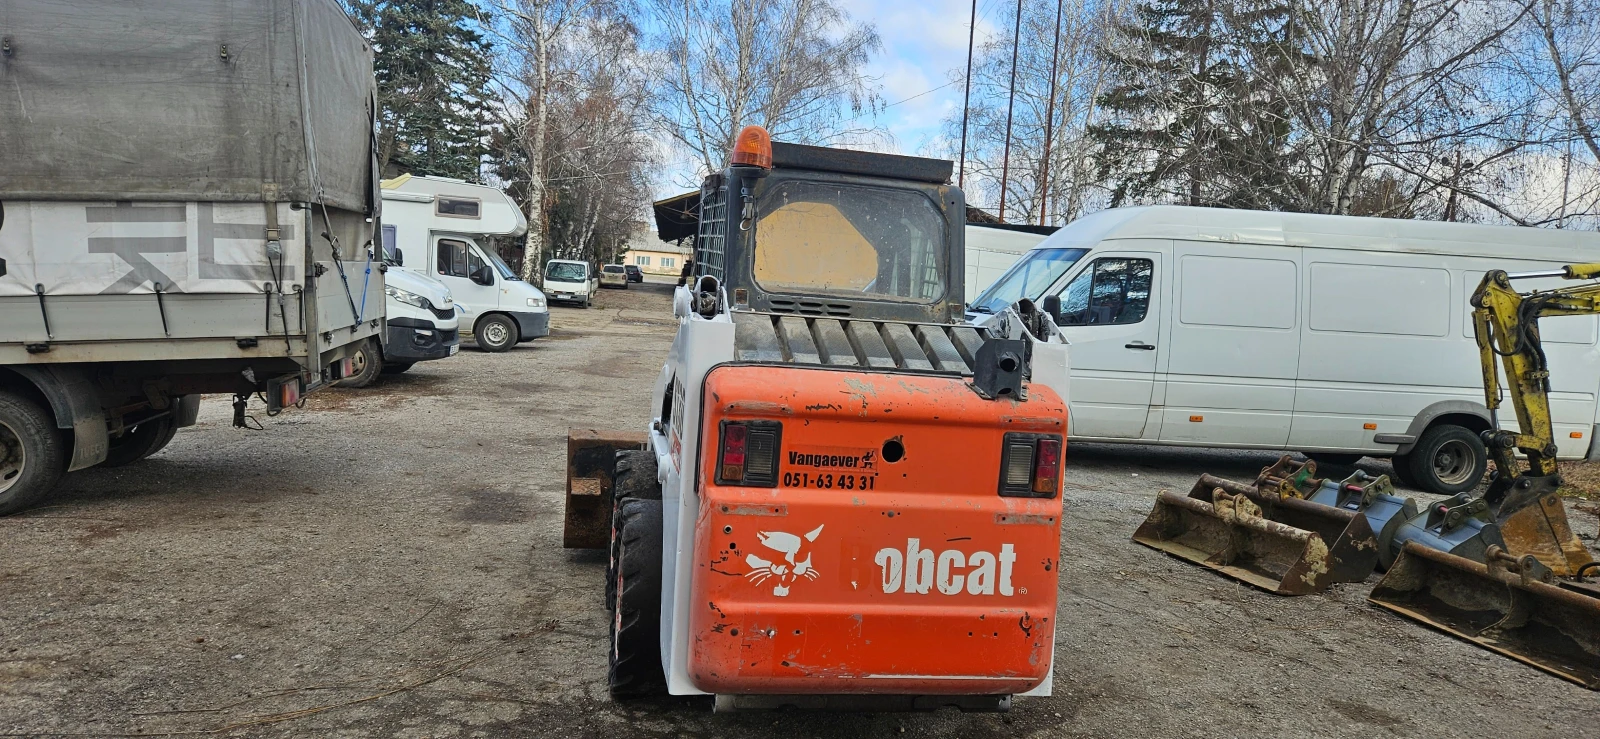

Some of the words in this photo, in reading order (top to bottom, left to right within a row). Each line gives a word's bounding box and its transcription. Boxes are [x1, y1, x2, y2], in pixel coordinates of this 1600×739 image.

[788, 450, 859, 468] Vangaever
[783, 471, 833, 489] 051-63
[838, 473, 855, 490] 43
[859, 475, 875, 491] 31
